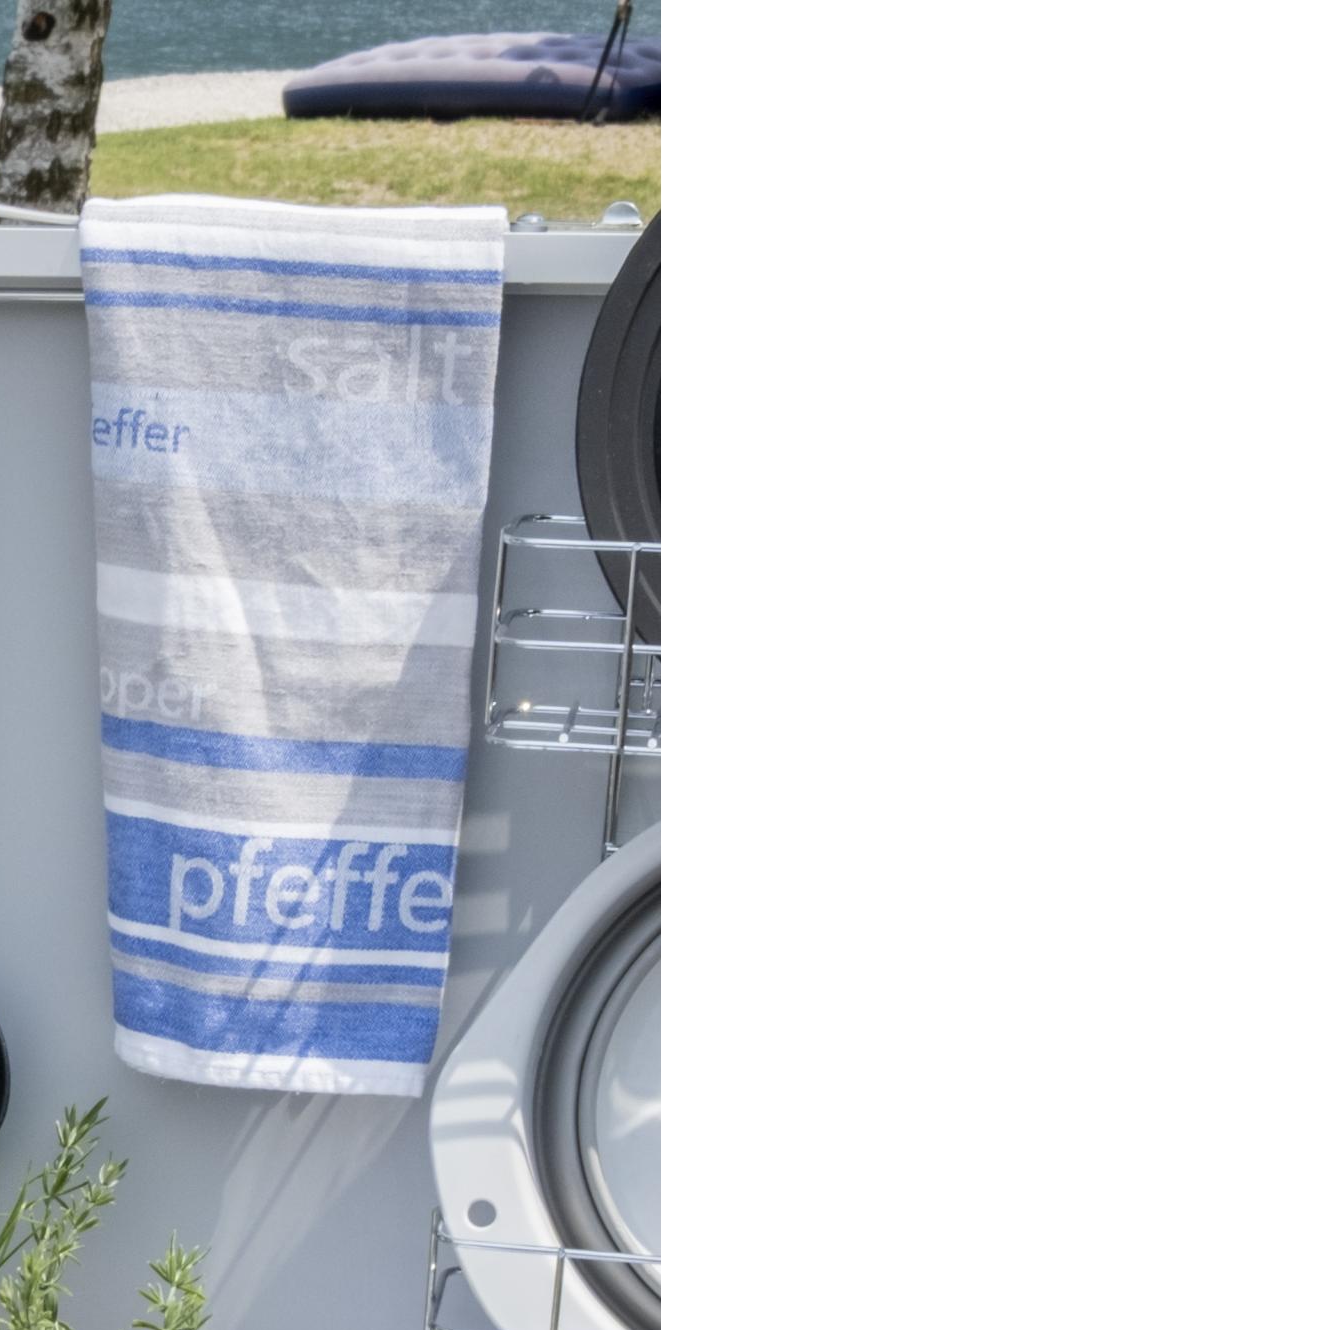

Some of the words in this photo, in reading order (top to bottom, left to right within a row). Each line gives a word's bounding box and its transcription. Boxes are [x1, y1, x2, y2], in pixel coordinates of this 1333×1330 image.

[284, 325, 473, 405] salt
[92, 407, 191, 453] effer
[169, 836, 453, 933] pfeffe
